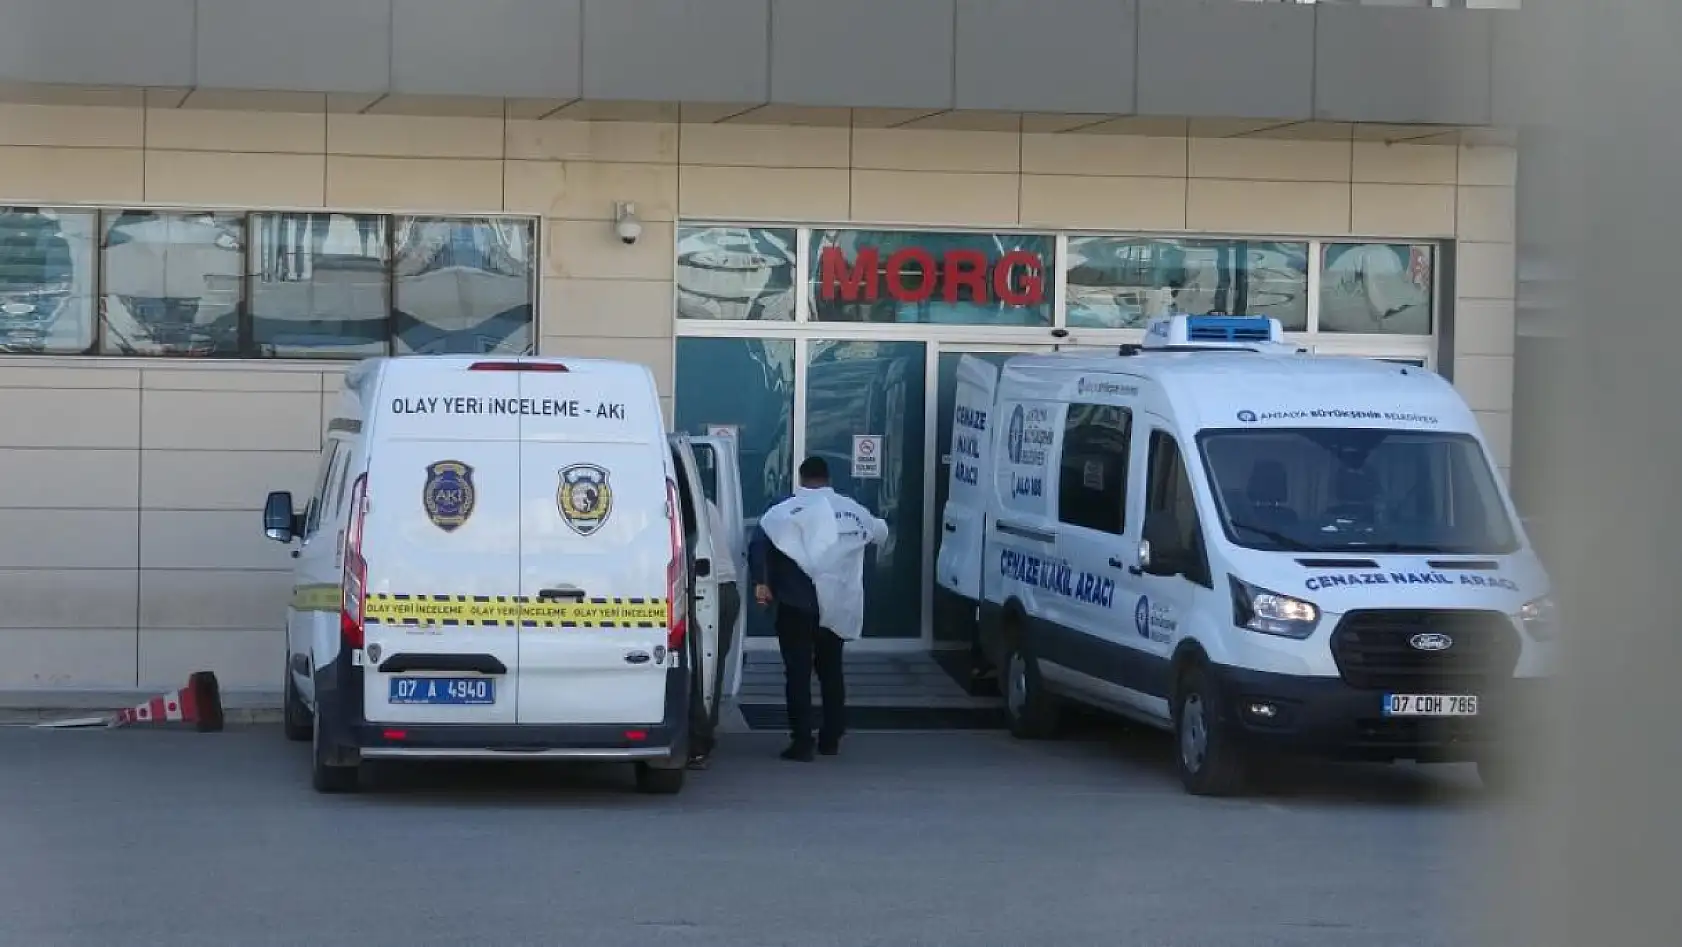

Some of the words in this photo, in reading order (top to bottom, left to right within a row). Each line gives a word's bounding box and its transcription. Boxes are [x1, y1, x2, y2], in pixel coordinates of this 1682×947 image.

[821, 246, 1044, 306] MORG
[391, 398, 438, 414] OLAY
[1001, 549, 1040, 586] CENAZE
[1075, 572, 1115, 608] ARACI
[1305, 572, 1387, 591] CENAZE
[366, 603, 389, 613] OLAY
[470, 606, 494, 615] OLAY
[574, 608, 597, 617] OLAY
[398, 680, 417, 697] 07
[427, 680, 437, 697] A
[448, 681, 487, 698] 4940
[1392, 696, 1409, 712] 07
